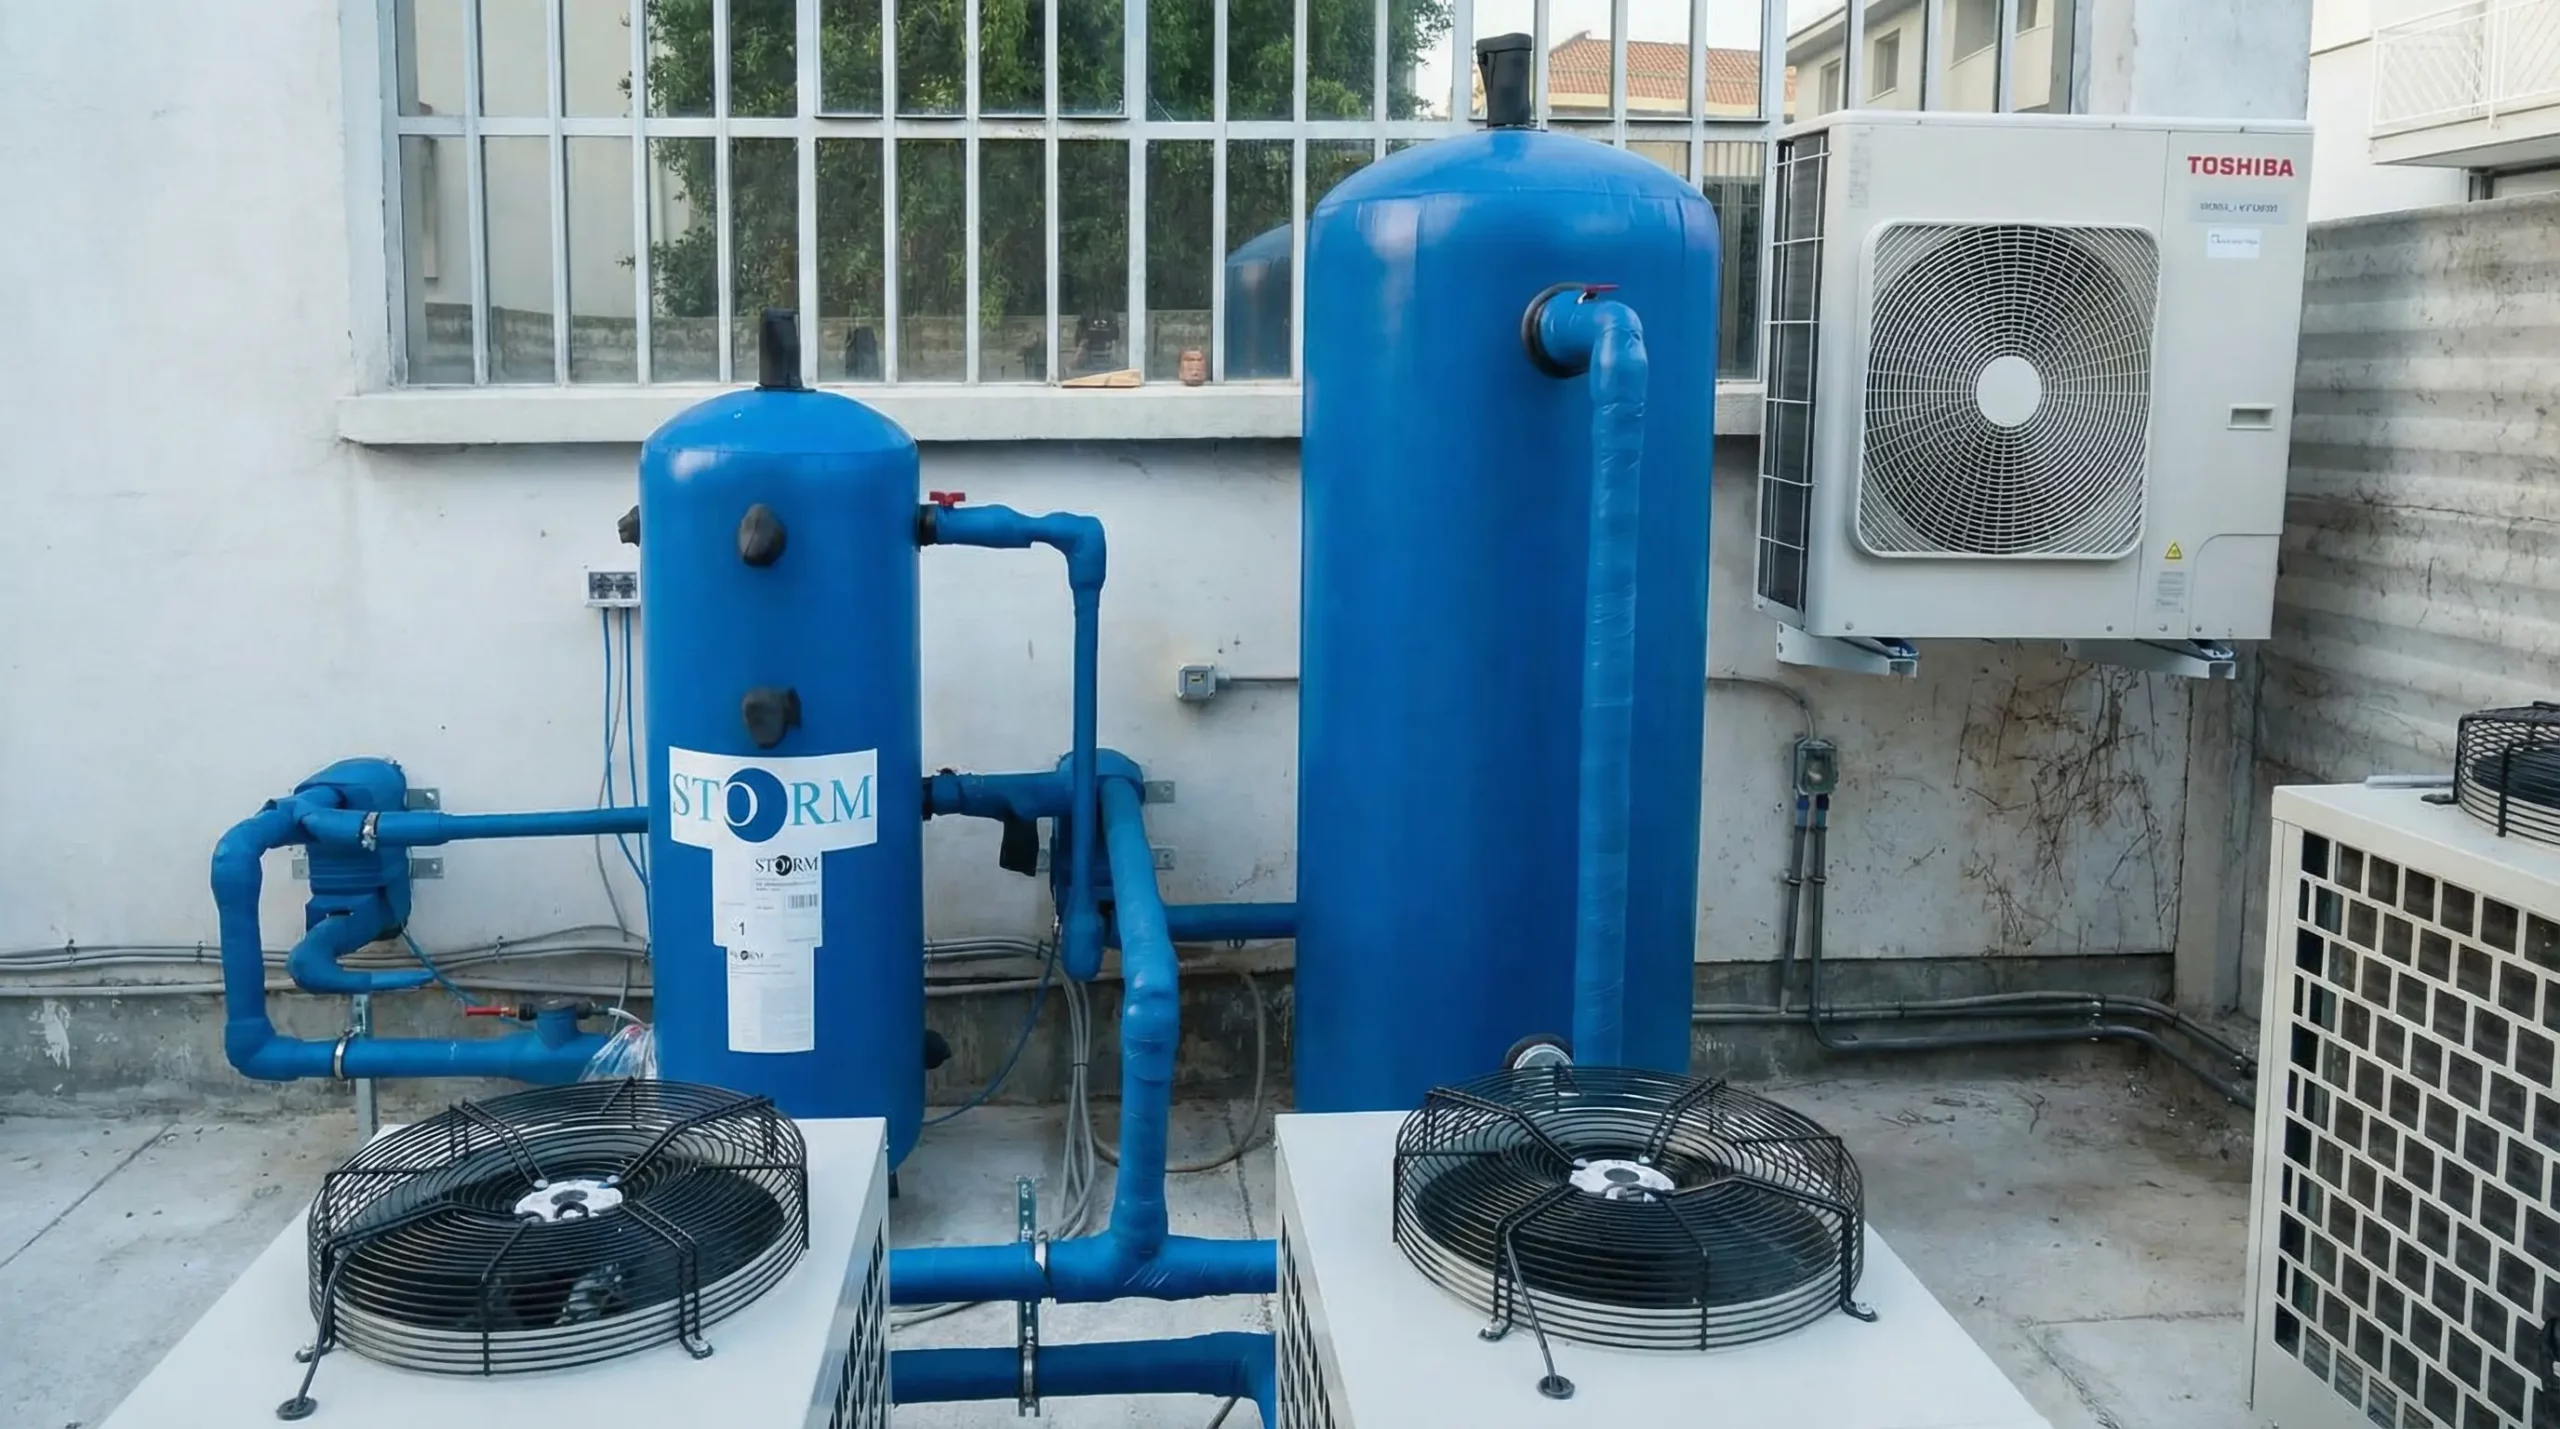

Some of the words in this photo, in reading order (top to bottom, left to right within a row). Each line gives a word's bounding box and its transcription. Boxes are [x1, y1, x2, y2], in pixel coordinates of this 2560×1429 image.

[2187, 155, 2294, 177] TOSHIBA
[673, 767, 873, 843] STORM
[755, 854, 818, 876] STORM
